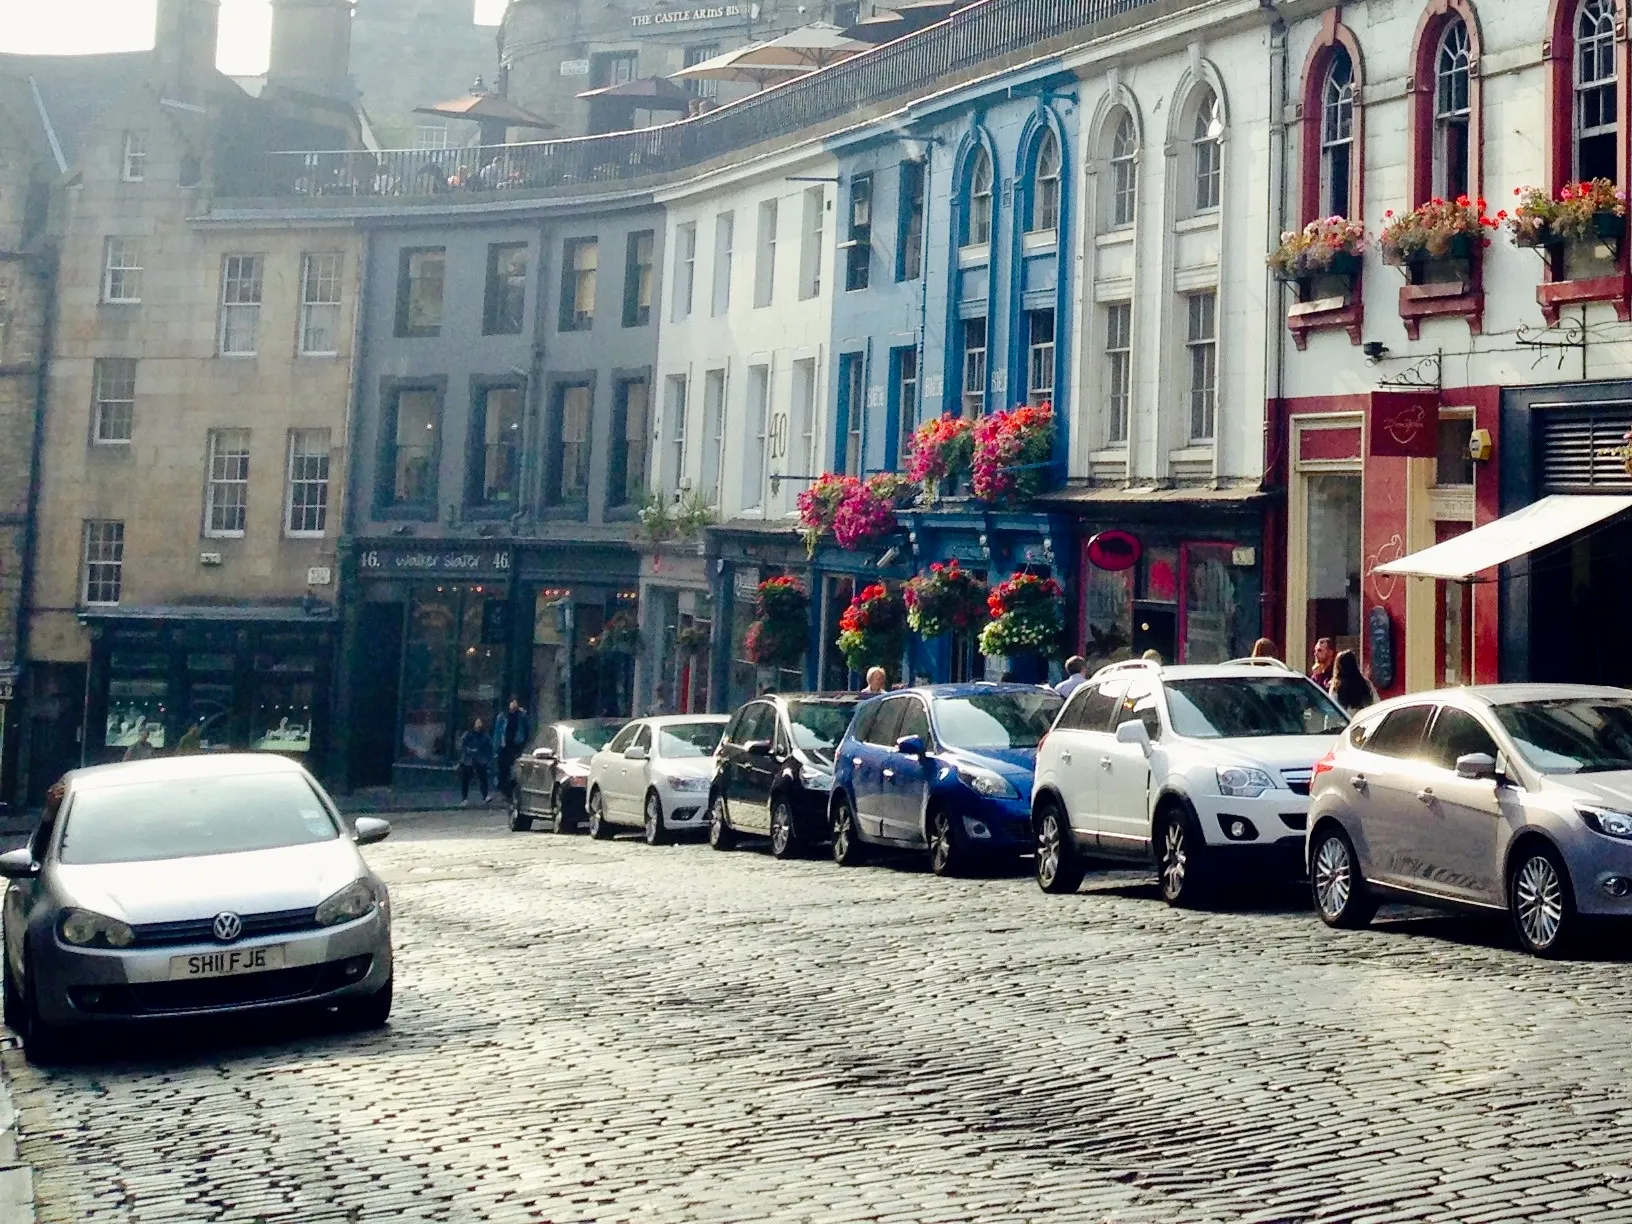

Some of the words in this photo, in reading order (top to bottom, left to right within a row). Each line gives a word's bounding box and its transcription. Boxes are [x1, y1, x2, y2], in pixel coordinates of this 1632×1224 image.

[631, 15, 651, 26] THE
[655, 11, 690, 24] CASTLE
[769, 412, 787, 459] 40
